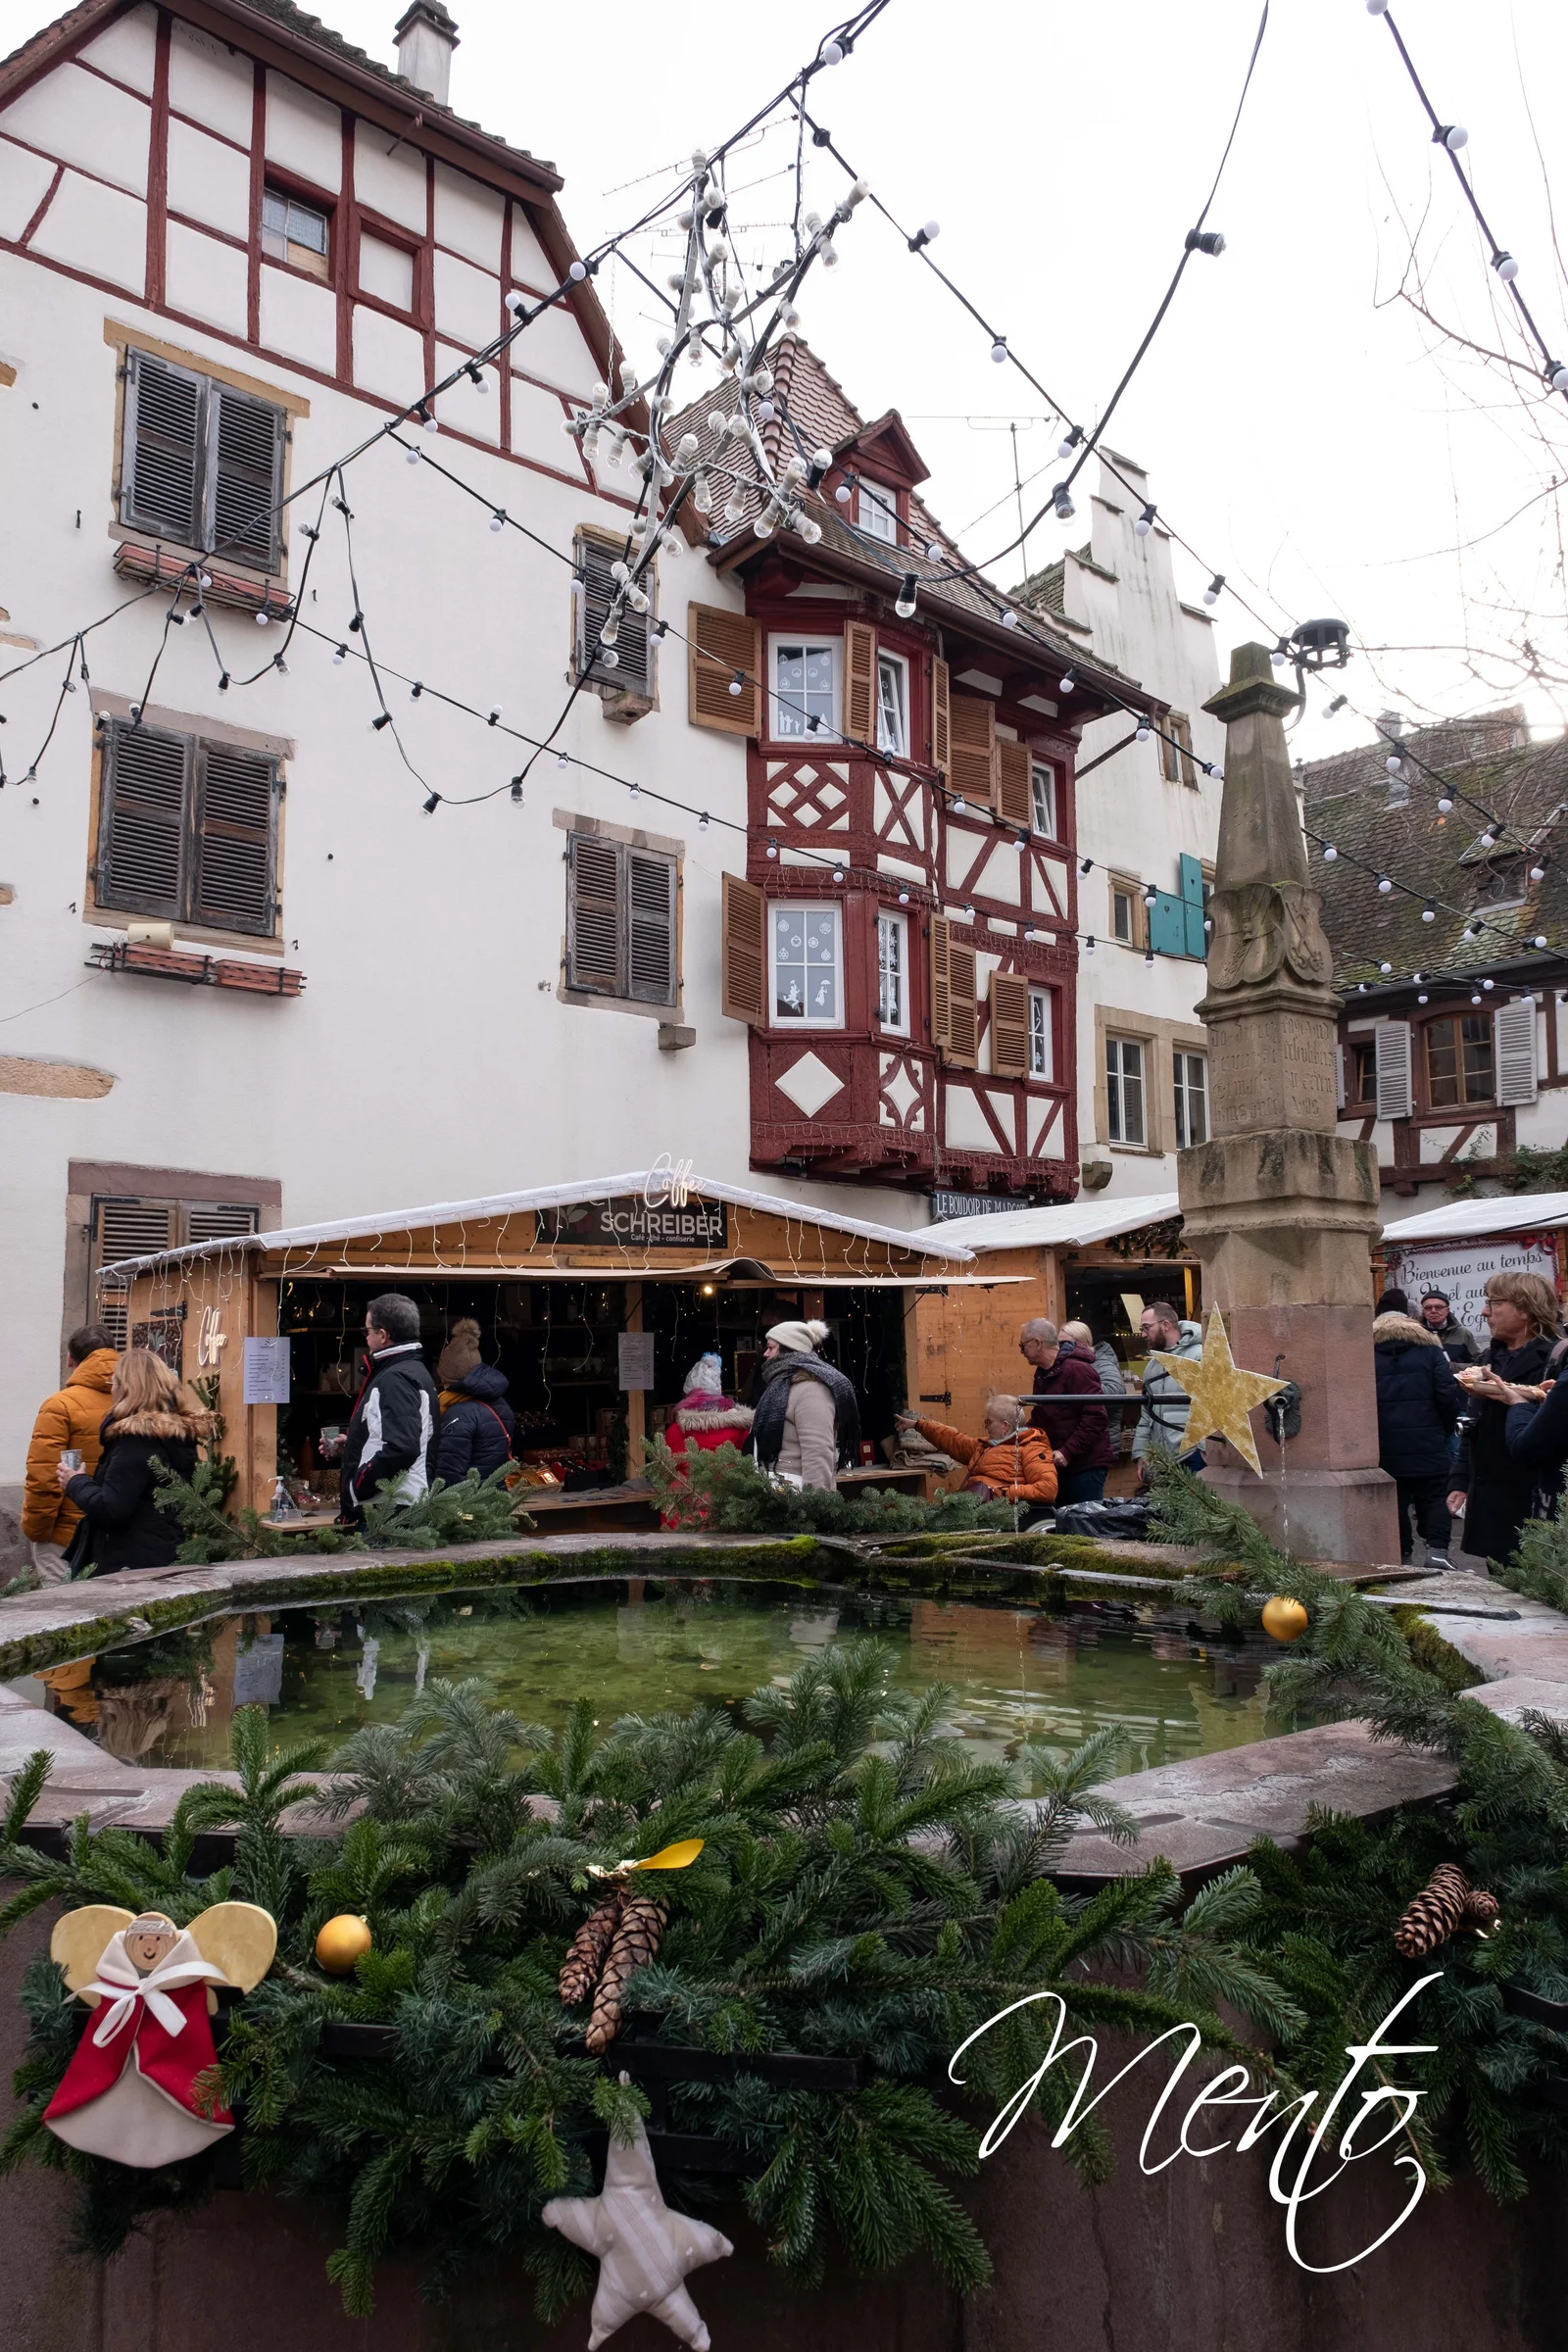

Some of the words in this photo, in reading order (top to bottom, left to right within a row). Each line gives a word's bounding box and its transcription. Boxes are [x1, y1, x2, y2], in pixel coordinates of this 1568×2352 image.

[644, 1152, 707, 1208] Coffee
[937, 1194, 948, 1213] LE
[949, 1195, 980, 1216] BOUDOIR
[982, 1199, 993, 1215] DE
[600, 1211, 722, 1237] SCHREIBER
[1400, 1260, 1472, 1286] Bienvenue
[1477, 1260, 1496, 1272] au
[1500, 1250, 1544, 1271] temps
[1420, 1281, 1460, 1301] Nël
